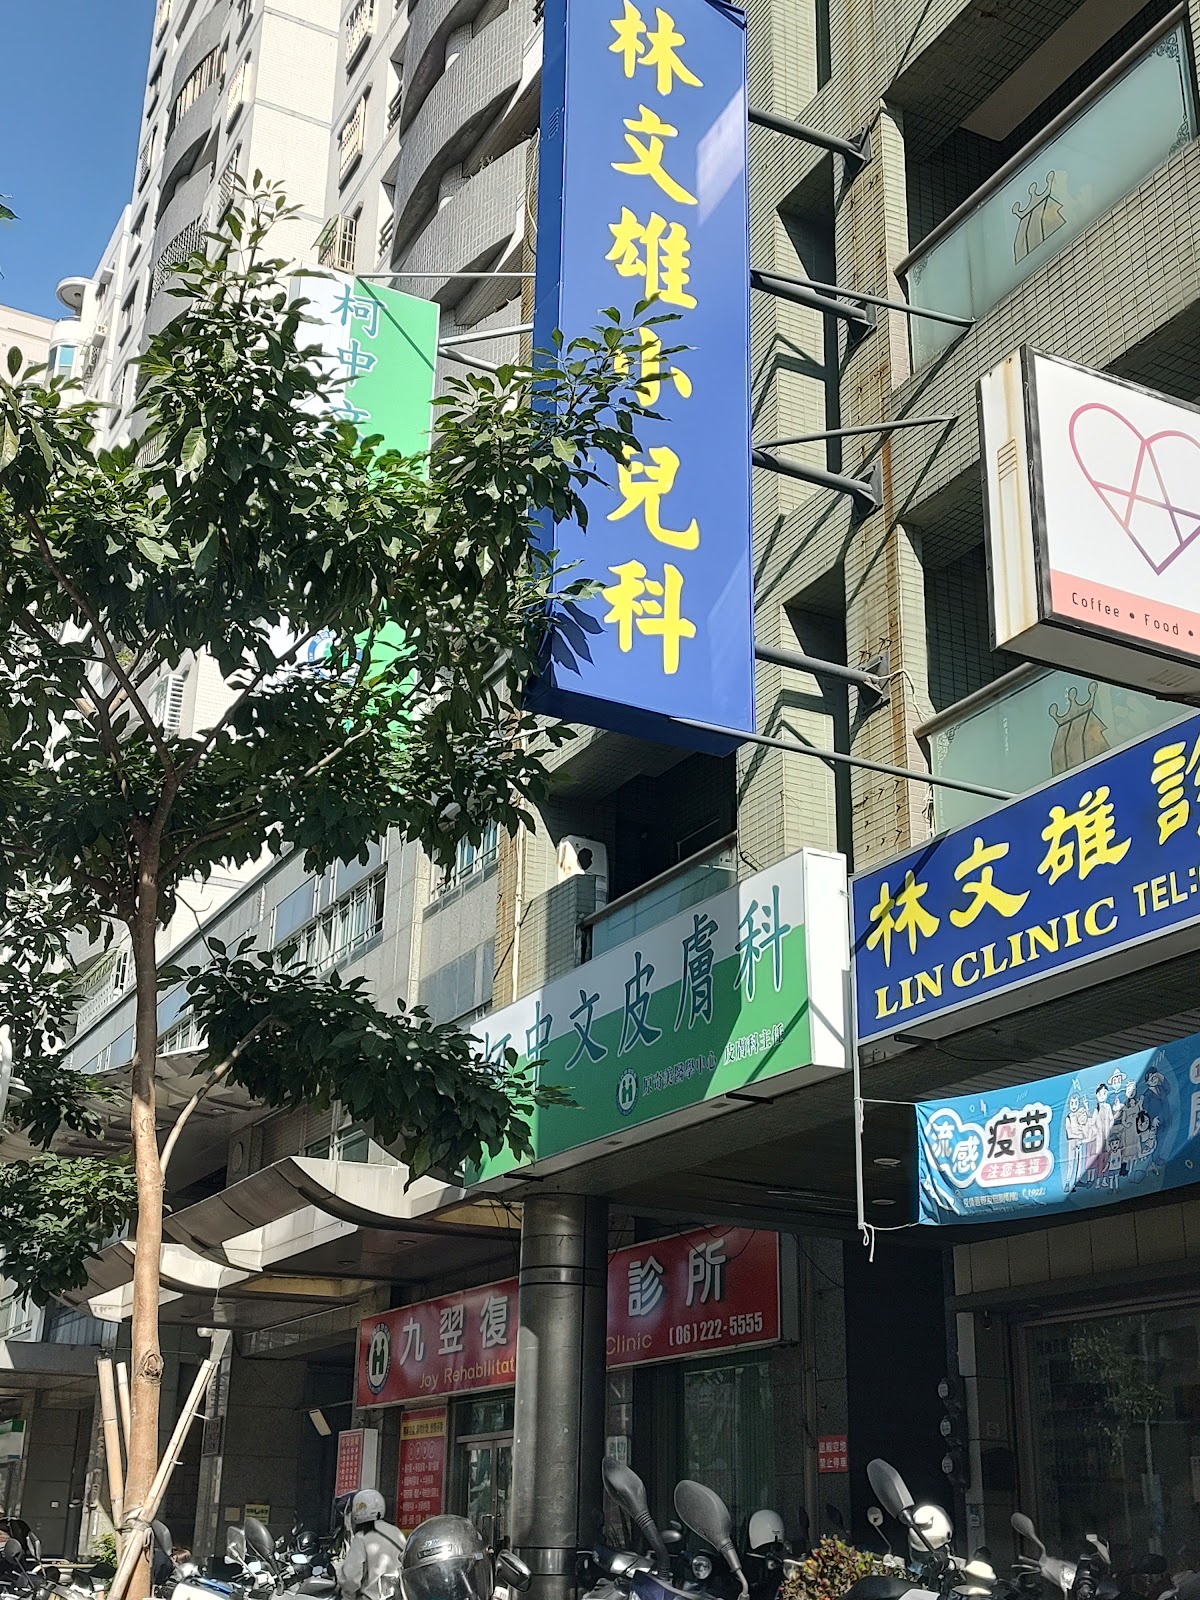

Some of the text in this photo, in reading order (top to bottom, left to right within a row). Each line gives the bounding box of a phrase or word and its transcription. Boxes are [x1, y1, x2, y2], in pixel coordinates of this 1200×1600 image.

[602, 0, 704, 674] 林文雄小兒科
[1072, 591, 1180, 636] Coffee Food
[875, 964, 944, 1020] LIN
[951, 897, 1119, 988] CLINIC
[987, 1109, 1048, 1159] 疫苗
[628, 1238, 727, 1318] 診所
[419, 1371, 439, 1391] Joy
